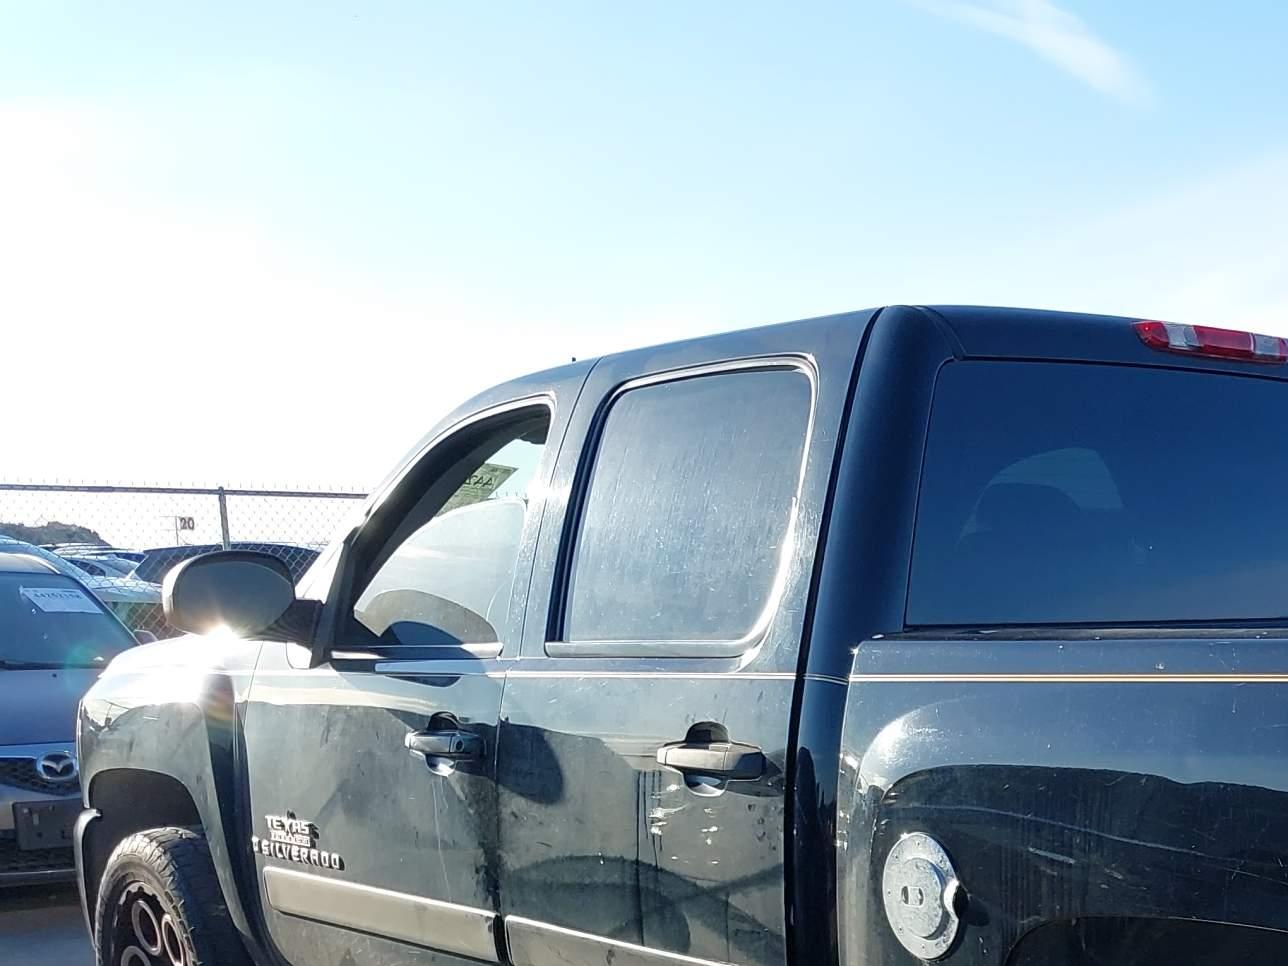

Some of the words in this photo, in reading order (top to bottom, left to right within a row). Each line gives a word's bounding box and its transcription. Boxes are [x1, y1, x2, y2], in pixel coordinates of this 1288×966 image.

[180, 516, 195, 530] 20
[264, 815, 312, 834] TEXAS
[261, 838, 342, 869] SILVERADO
